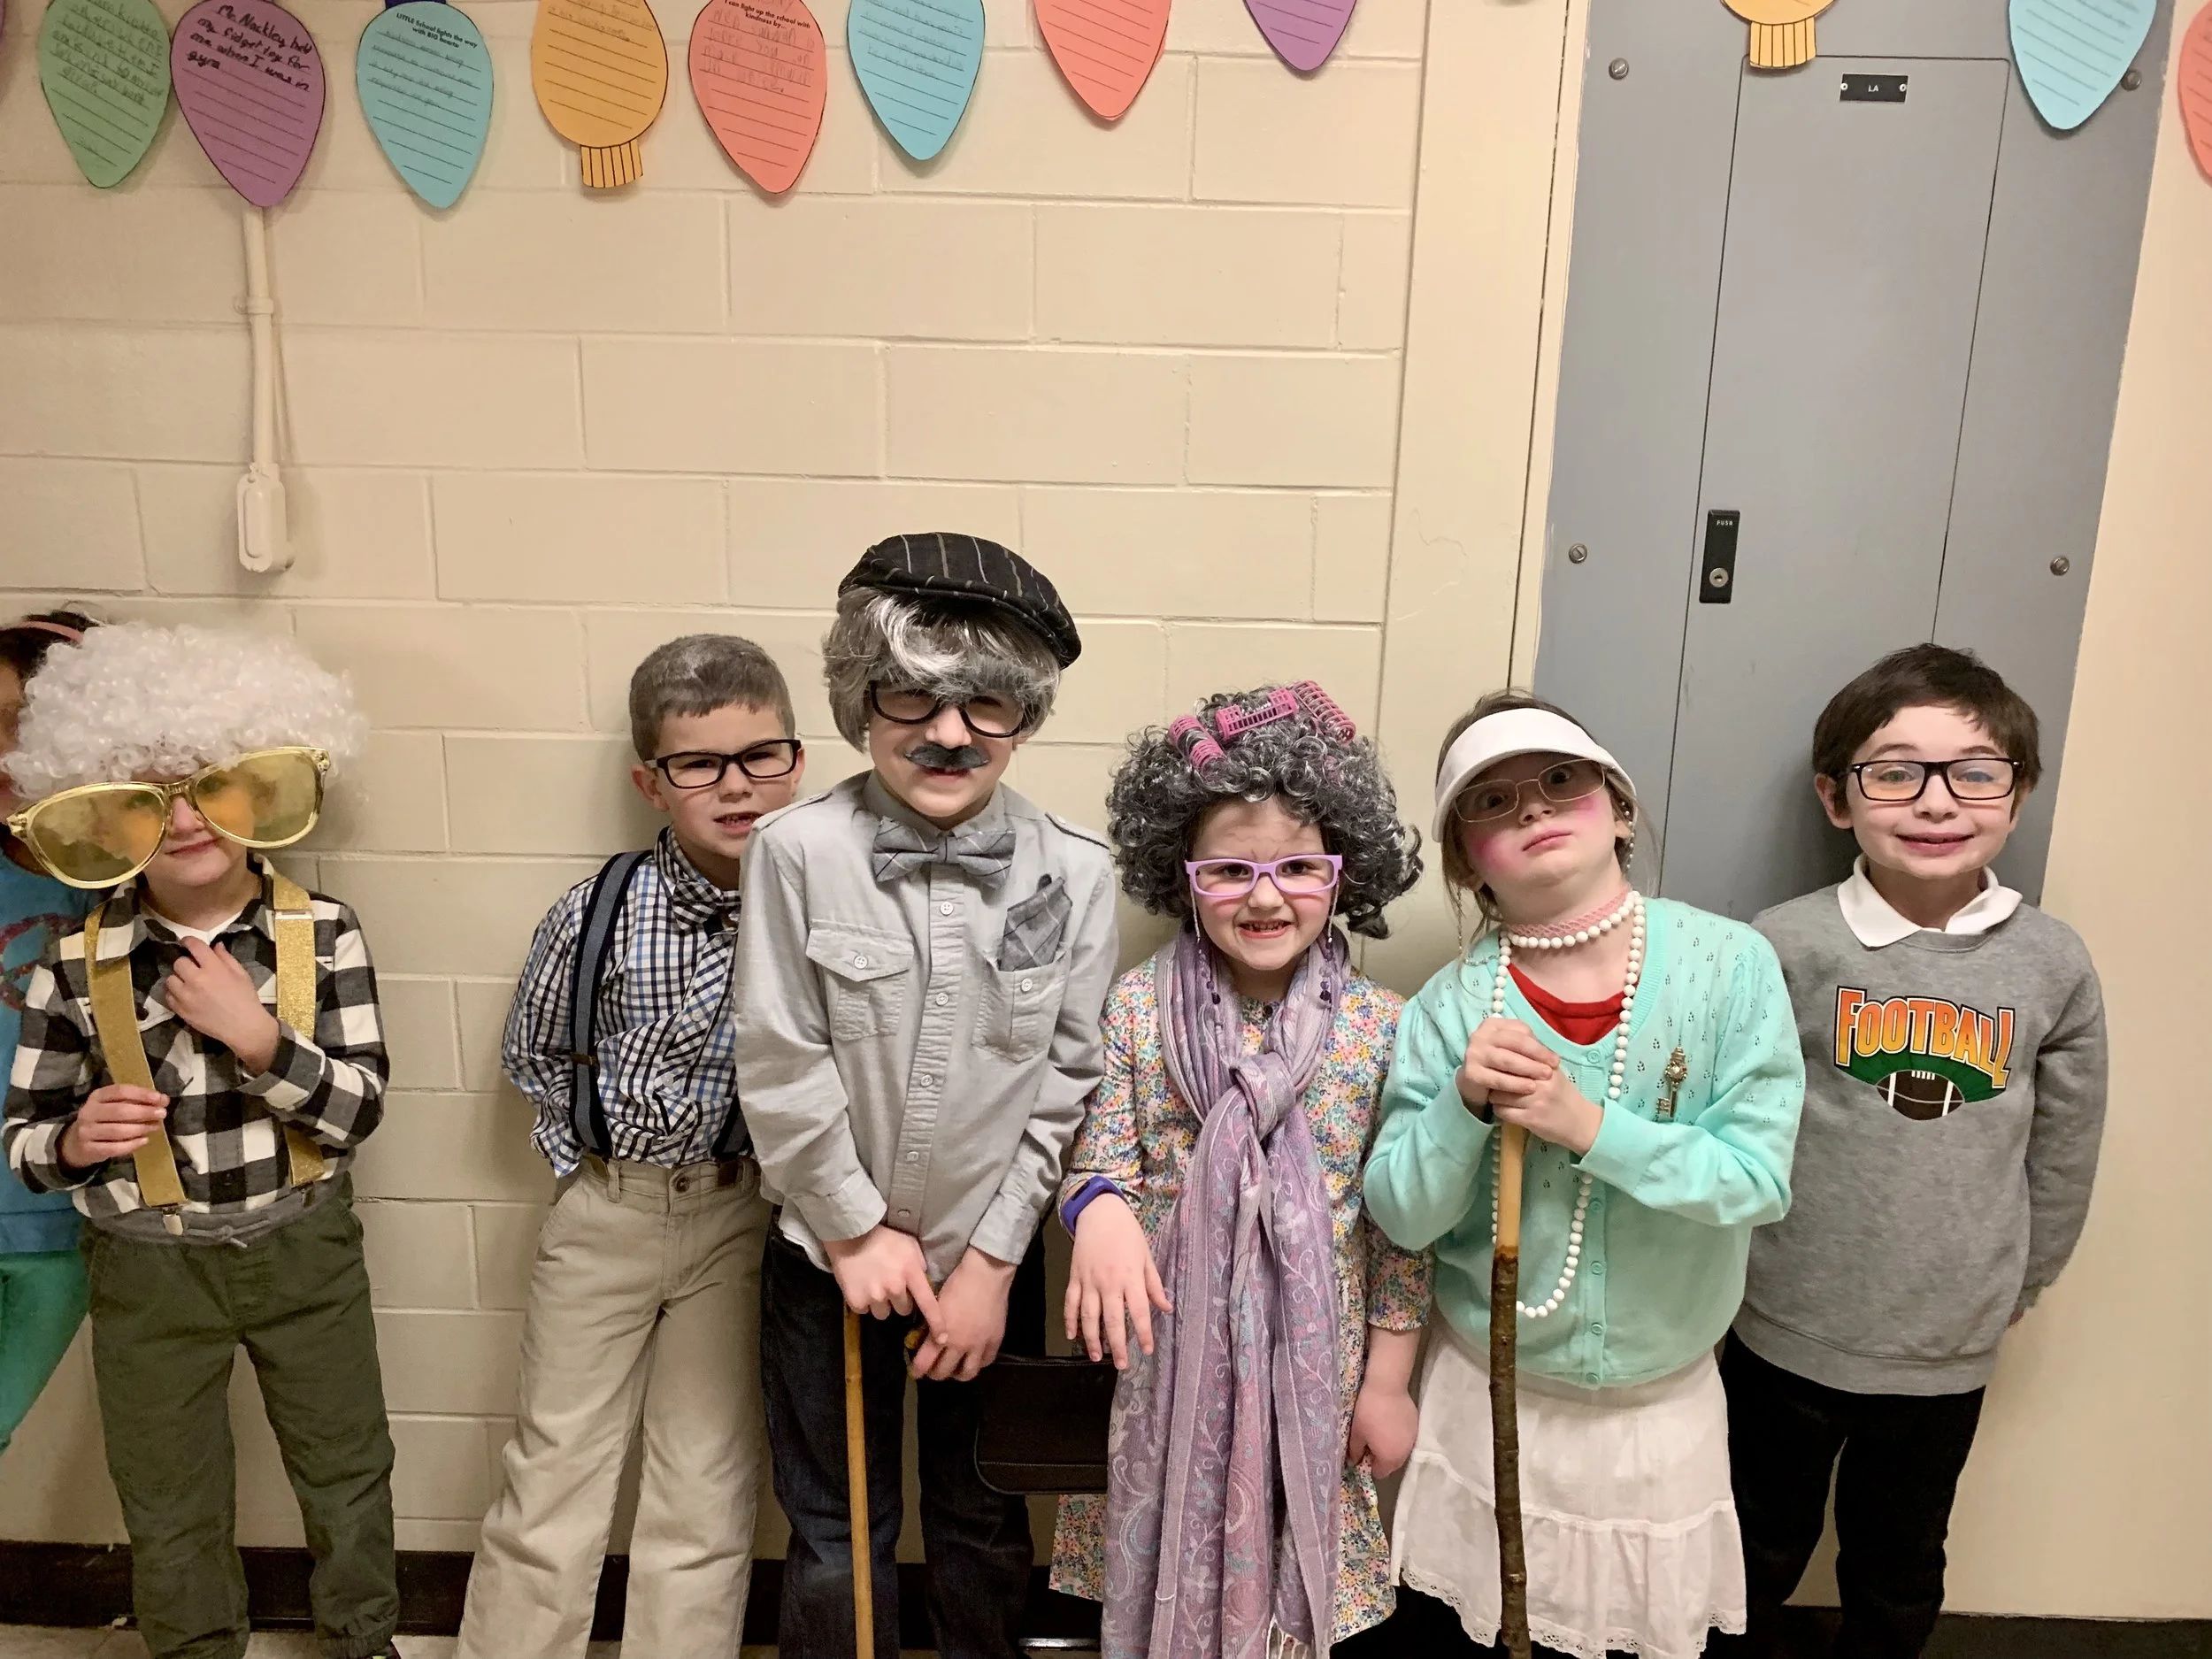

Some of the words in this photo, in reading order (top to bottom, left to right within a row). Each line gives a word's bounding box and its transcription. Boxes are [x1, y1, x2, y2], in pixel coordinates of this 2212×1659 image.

[741, 3, 755, 12] light
[776, 15, 796, 25] school
[797, 20, 810, 29] with
[745, 12, 772, 26] kindness
[412, 27, 426, 36] with
[416, 19, 436, 32] School
[436, 27, 453, 40] lights
[453, 35, 463, 43] the
[464, 40, 478, 49] way
[249, 54, 265, 68] I
[1868, 84, 1879, 93] LA
[1833, 986, 2016, 1089] FOOTBALL
